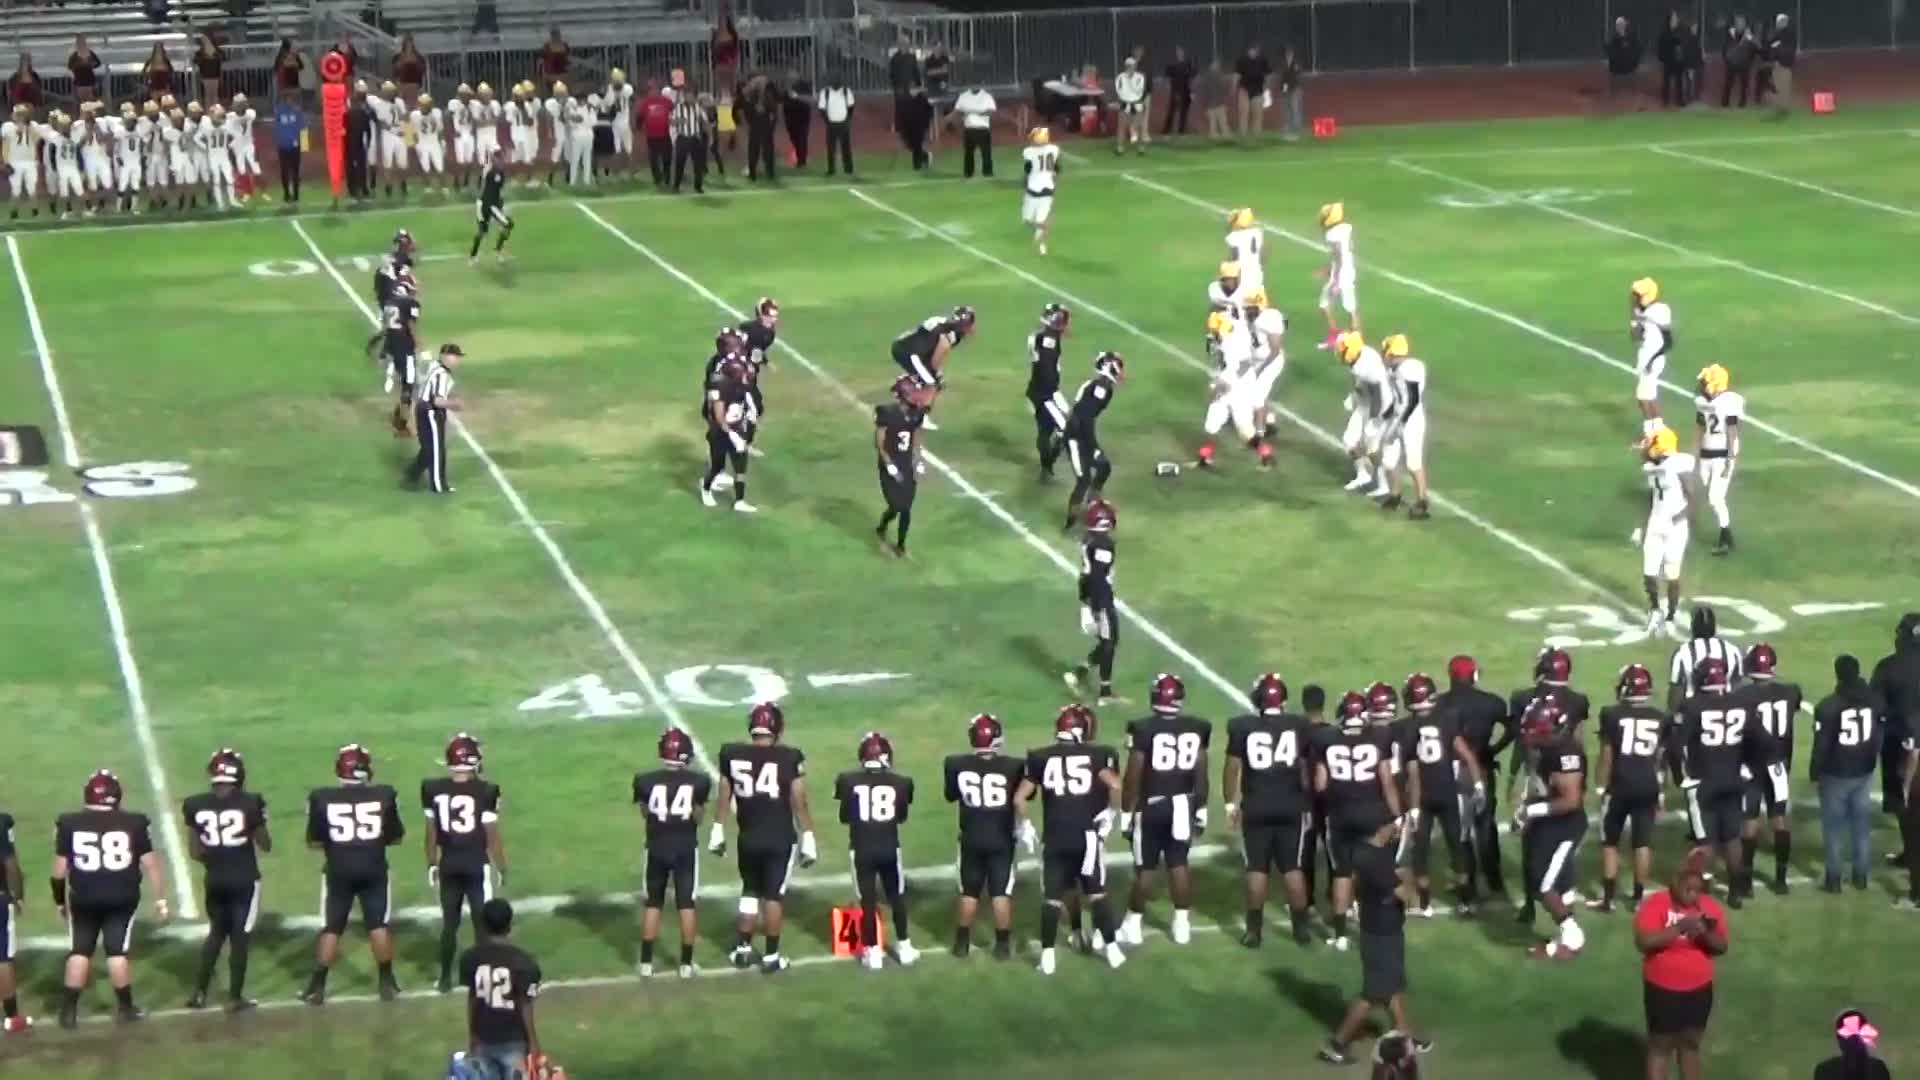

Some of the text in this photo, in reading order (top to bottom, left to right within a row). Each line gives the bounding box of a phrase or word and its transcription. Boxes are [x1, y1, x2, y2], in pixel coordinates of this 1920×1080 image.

[897, 431, 911, 451] 3
[1507, 596, 1787, 647] 30
[518, 664, 790, 719] 40
[1619, 717, 1660, 756] 15
[1700, 708, 1746, 746] 52
[1757, 700, 1788, 738] 11
[1838, 707, 1873, 746] 51
[1151, 732, 1201, 771] 68
[1246, 730, 1298, 770] 64
[1326, 743, 1378, 782] 62
[1416, 725, 1442, 764] 6
[729, 759, 780, 799] 54
[957, 770, 1008, 808] 66
[1043, 755, 1093, 796] 45
[327, 802, 382, 843] 55
[434, 795, 475, 833] 13
[649, 784, 694, 822] 44
[853, 784, 897, 822] 18
[195, 809, 248, 848] 32
[72, 831, 132, 872] 58
[475, 964, 515, 1010] 42
